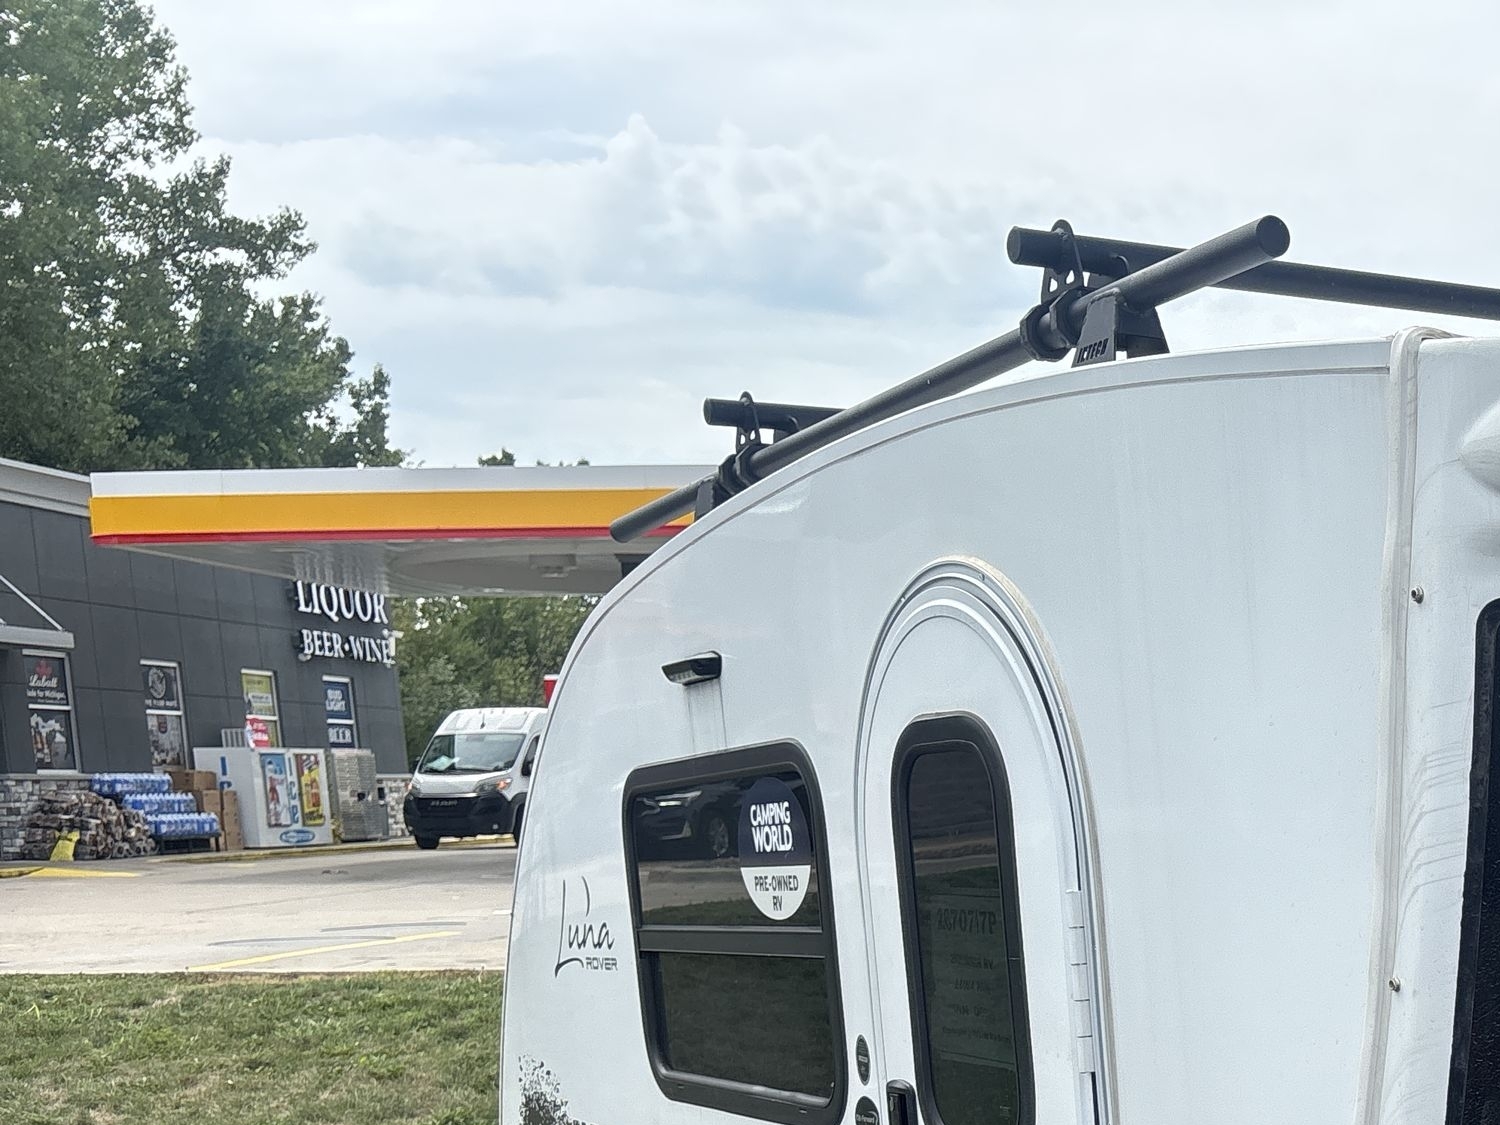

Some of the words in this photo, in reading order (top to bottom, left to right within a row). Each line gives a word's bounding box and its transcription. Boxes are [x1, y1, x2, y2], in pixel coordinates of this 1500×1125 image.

[297, 580, 389, 624] LIQUOR
[29, 674, 58, 688] Labatt
[327, 689, 343, 701] BUD
[328, 727, 352, 744] BEER
[750, 801, 791, 827] CAMPING
[751, 824, 794, 853] WORLD
[754, 875, 799, 892] PRE-OWNED
[772, 895, 783, 911] RV
[554, 878, 615, 978] Luna
[585, 957, 618, 971] ROVER
